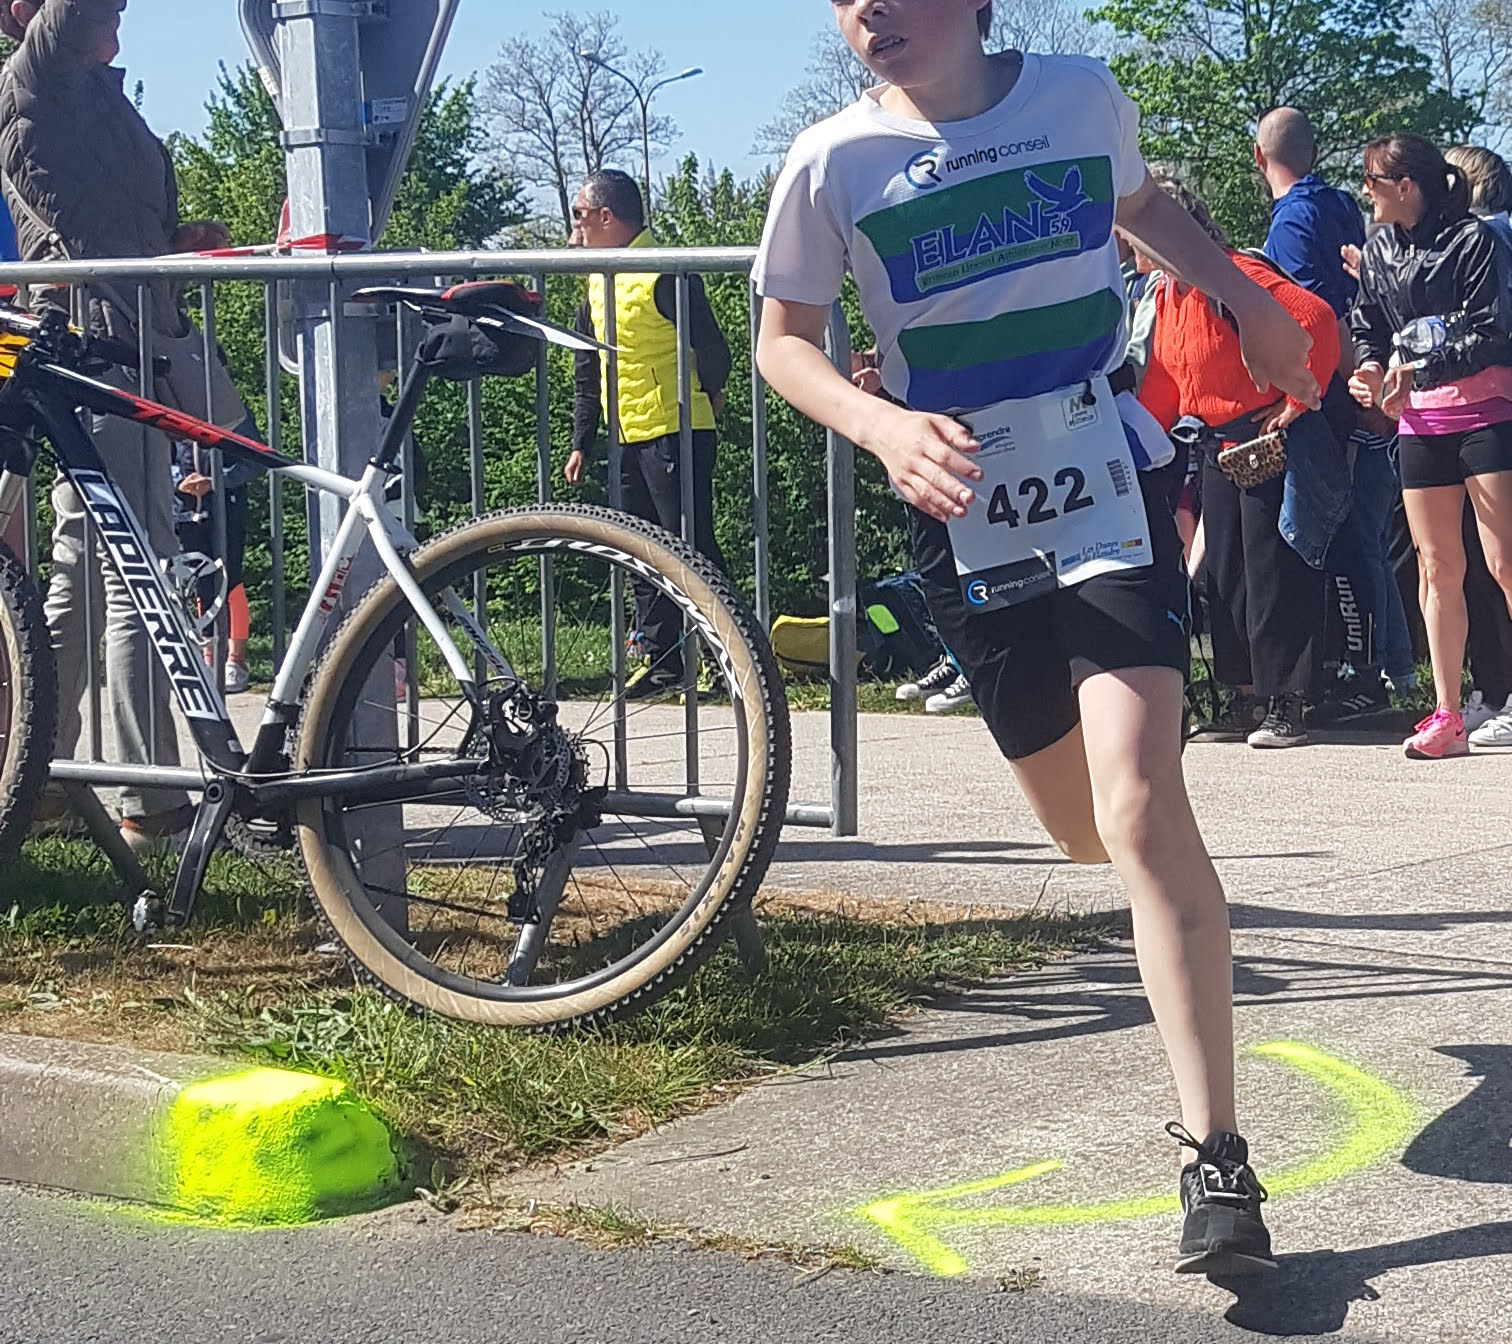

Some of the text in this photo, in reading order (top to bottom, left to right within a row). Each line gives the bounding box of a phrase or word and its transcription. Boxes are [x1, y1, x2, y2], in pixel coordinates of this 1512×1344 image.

[945, 135, 1051, 173] running conseil
[910, 200, 1042, 274] ELAN
[986, 466, 1095, 529] 422
[68, 468, 220, 722] LAPIERRE
[990, 578, 1024, 594] running
